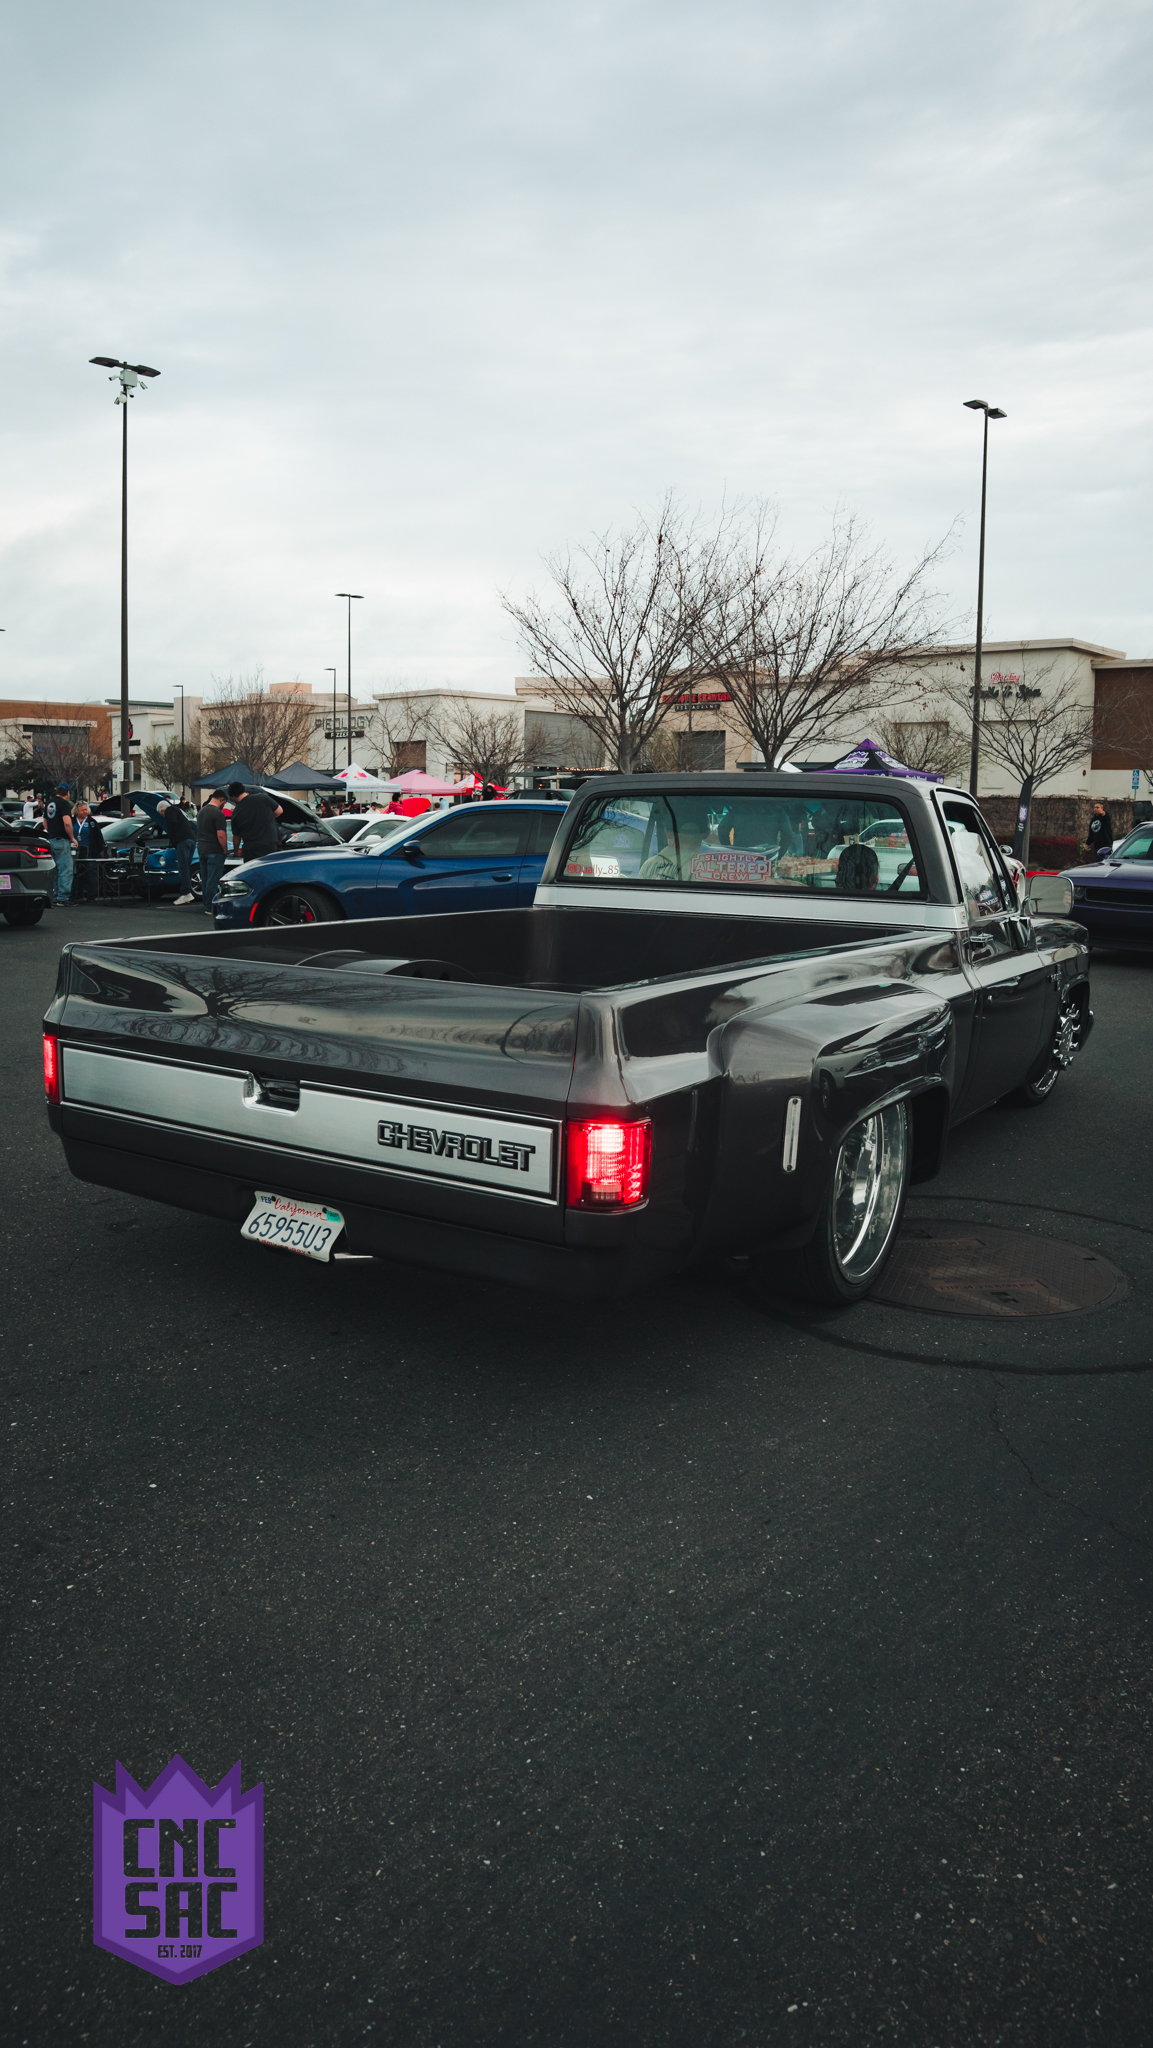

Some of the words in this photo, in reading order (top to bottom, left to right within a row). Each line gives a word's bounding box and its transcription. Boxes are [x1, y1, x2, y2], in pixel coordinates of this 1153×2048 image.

[315, 715, 374, 731] PIEOLOGY
[704, 854, 758, 863] SLIGHTLY
[695, 861, 768, 874] ALTERED
[713, 872, 748, 881] CREW
[377, 1120, 536, 1172] CHEVROLET
[260, 1195, 272, 1204] FEB
[274, 1198, 327, 1221] California
[248, 1212, 333, 1252] 65955U3
